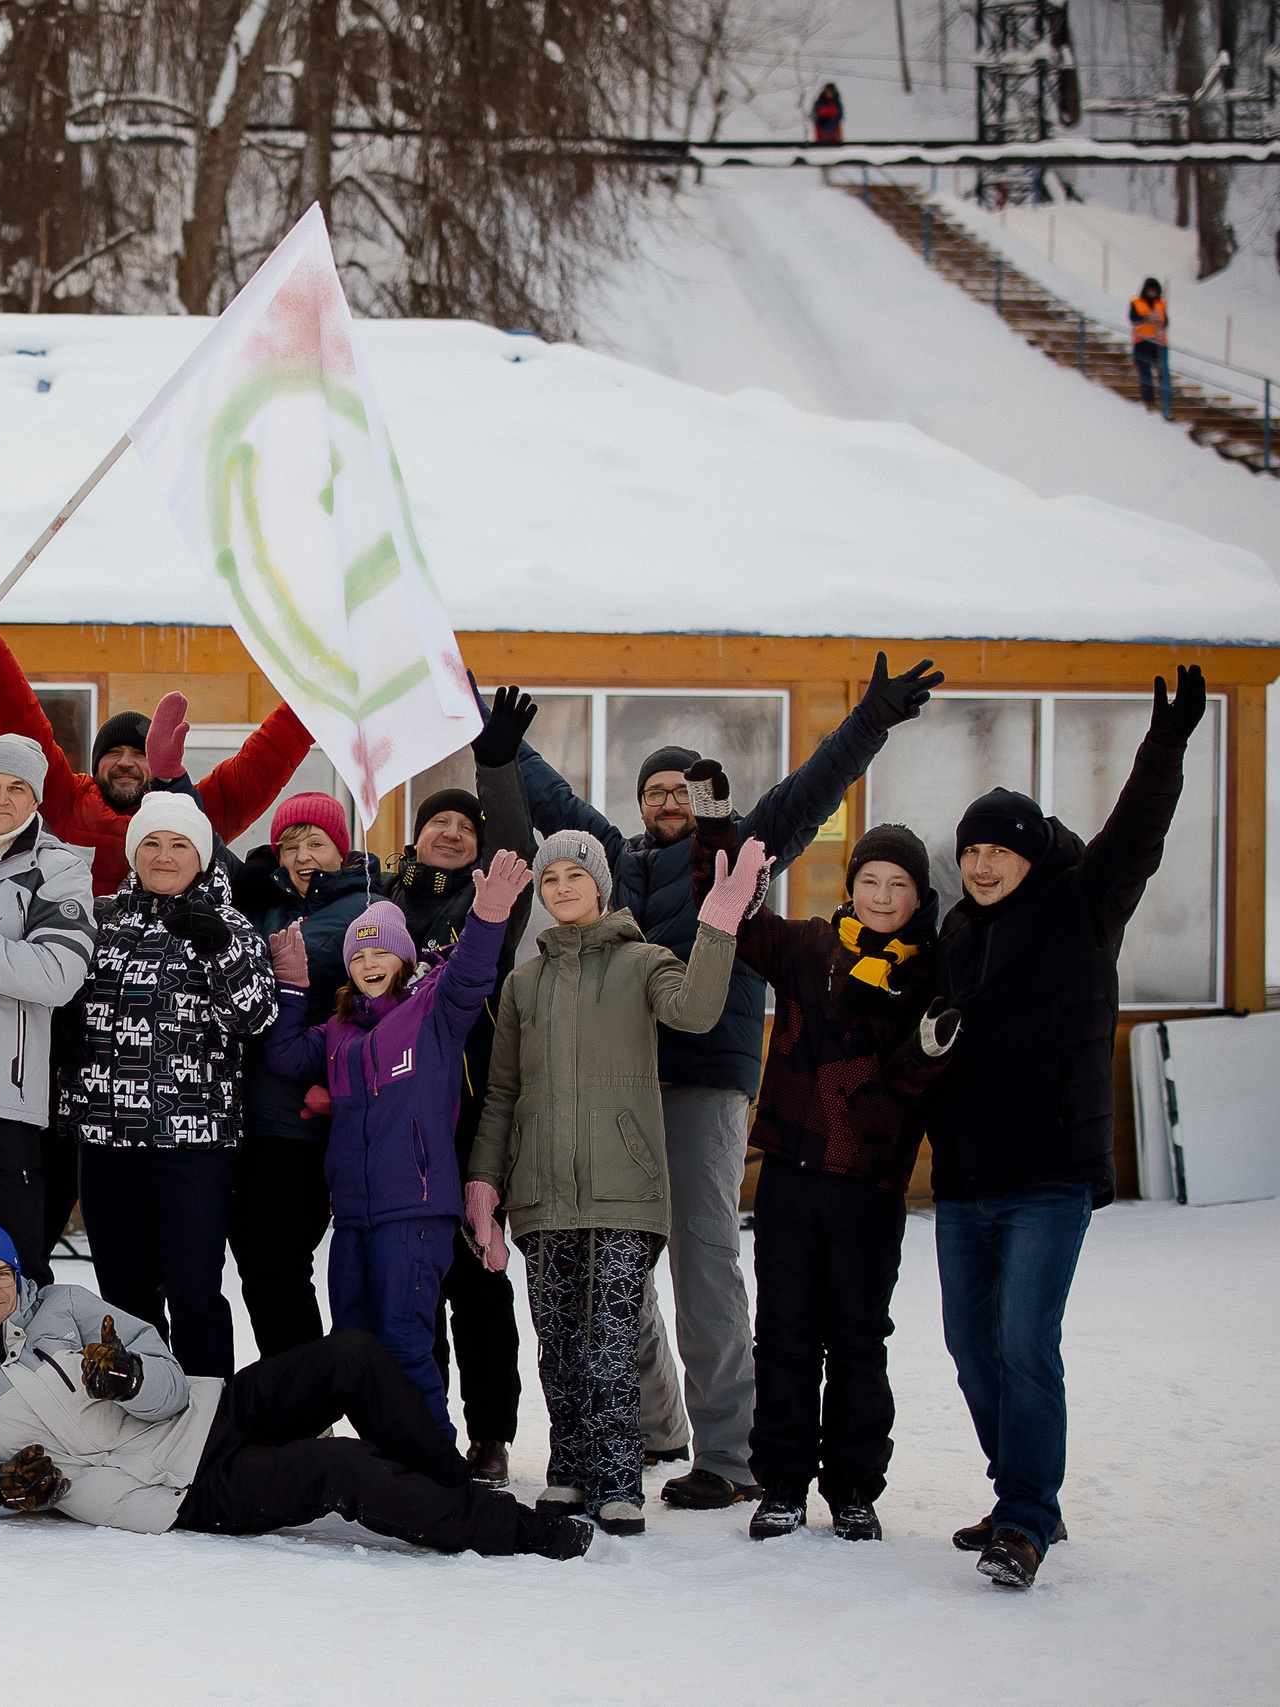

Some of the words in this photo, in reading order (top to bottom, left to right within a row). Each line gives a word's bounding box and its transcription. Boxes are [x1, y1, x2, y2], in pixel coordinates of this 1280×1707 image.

[166, 962, 187, 971] FILA
[122, 972, 158, 985] FILA
[159, 1023, 181, 1032] FILA
[116, 1031, 152, 1046] FILA
[210, 1052, 225, 1060] FILA
[157, 1085, 179, 1094] FILA
[72, 1094, 89, 1104] FILA
[113, 1094, 152, 1108] FILA
[175, 1129, 212, 1143] FILA
